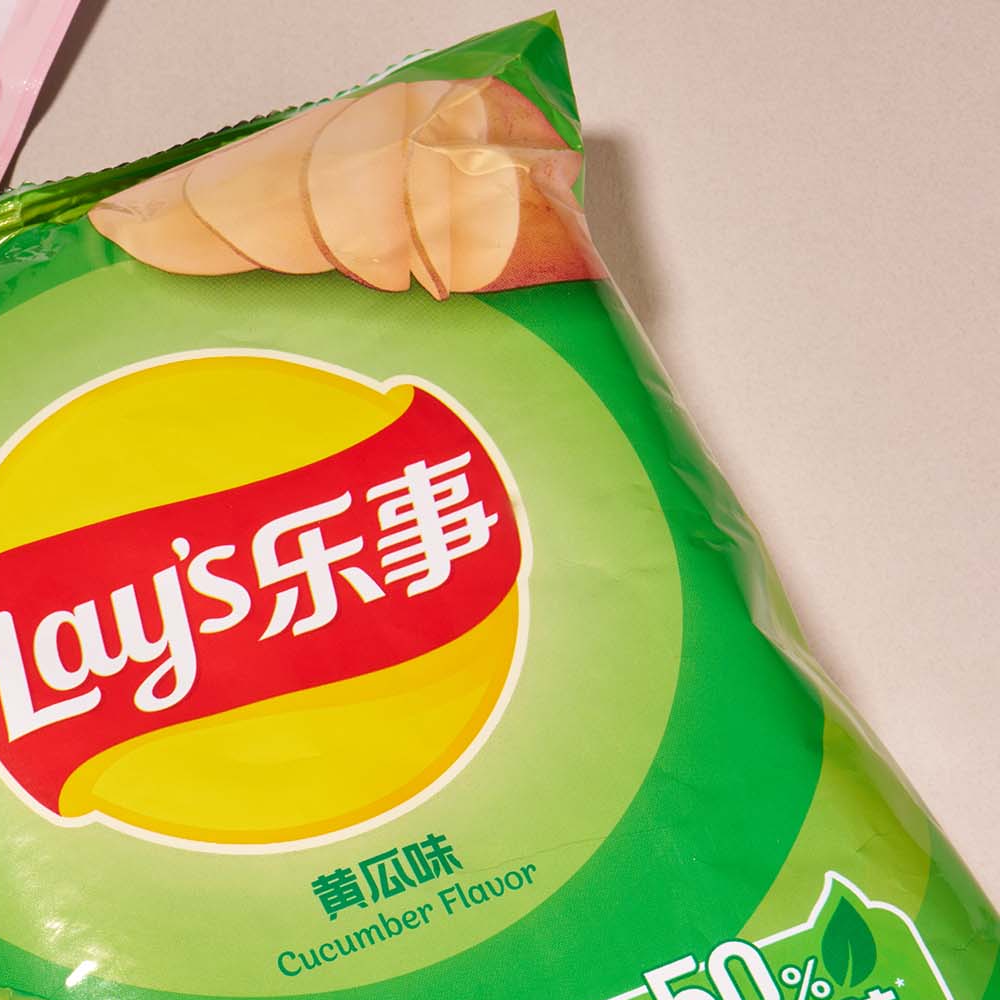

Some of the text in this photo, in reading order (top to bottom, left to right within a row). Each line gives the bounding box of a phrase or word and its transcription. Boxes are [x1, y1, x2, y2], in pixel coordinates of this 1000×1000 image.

[251, 452, 499, 641] 乐事
[277, 861, 538, 978] Cucumber Flavor
[311, 832, 464, 921] 黄瓜味
